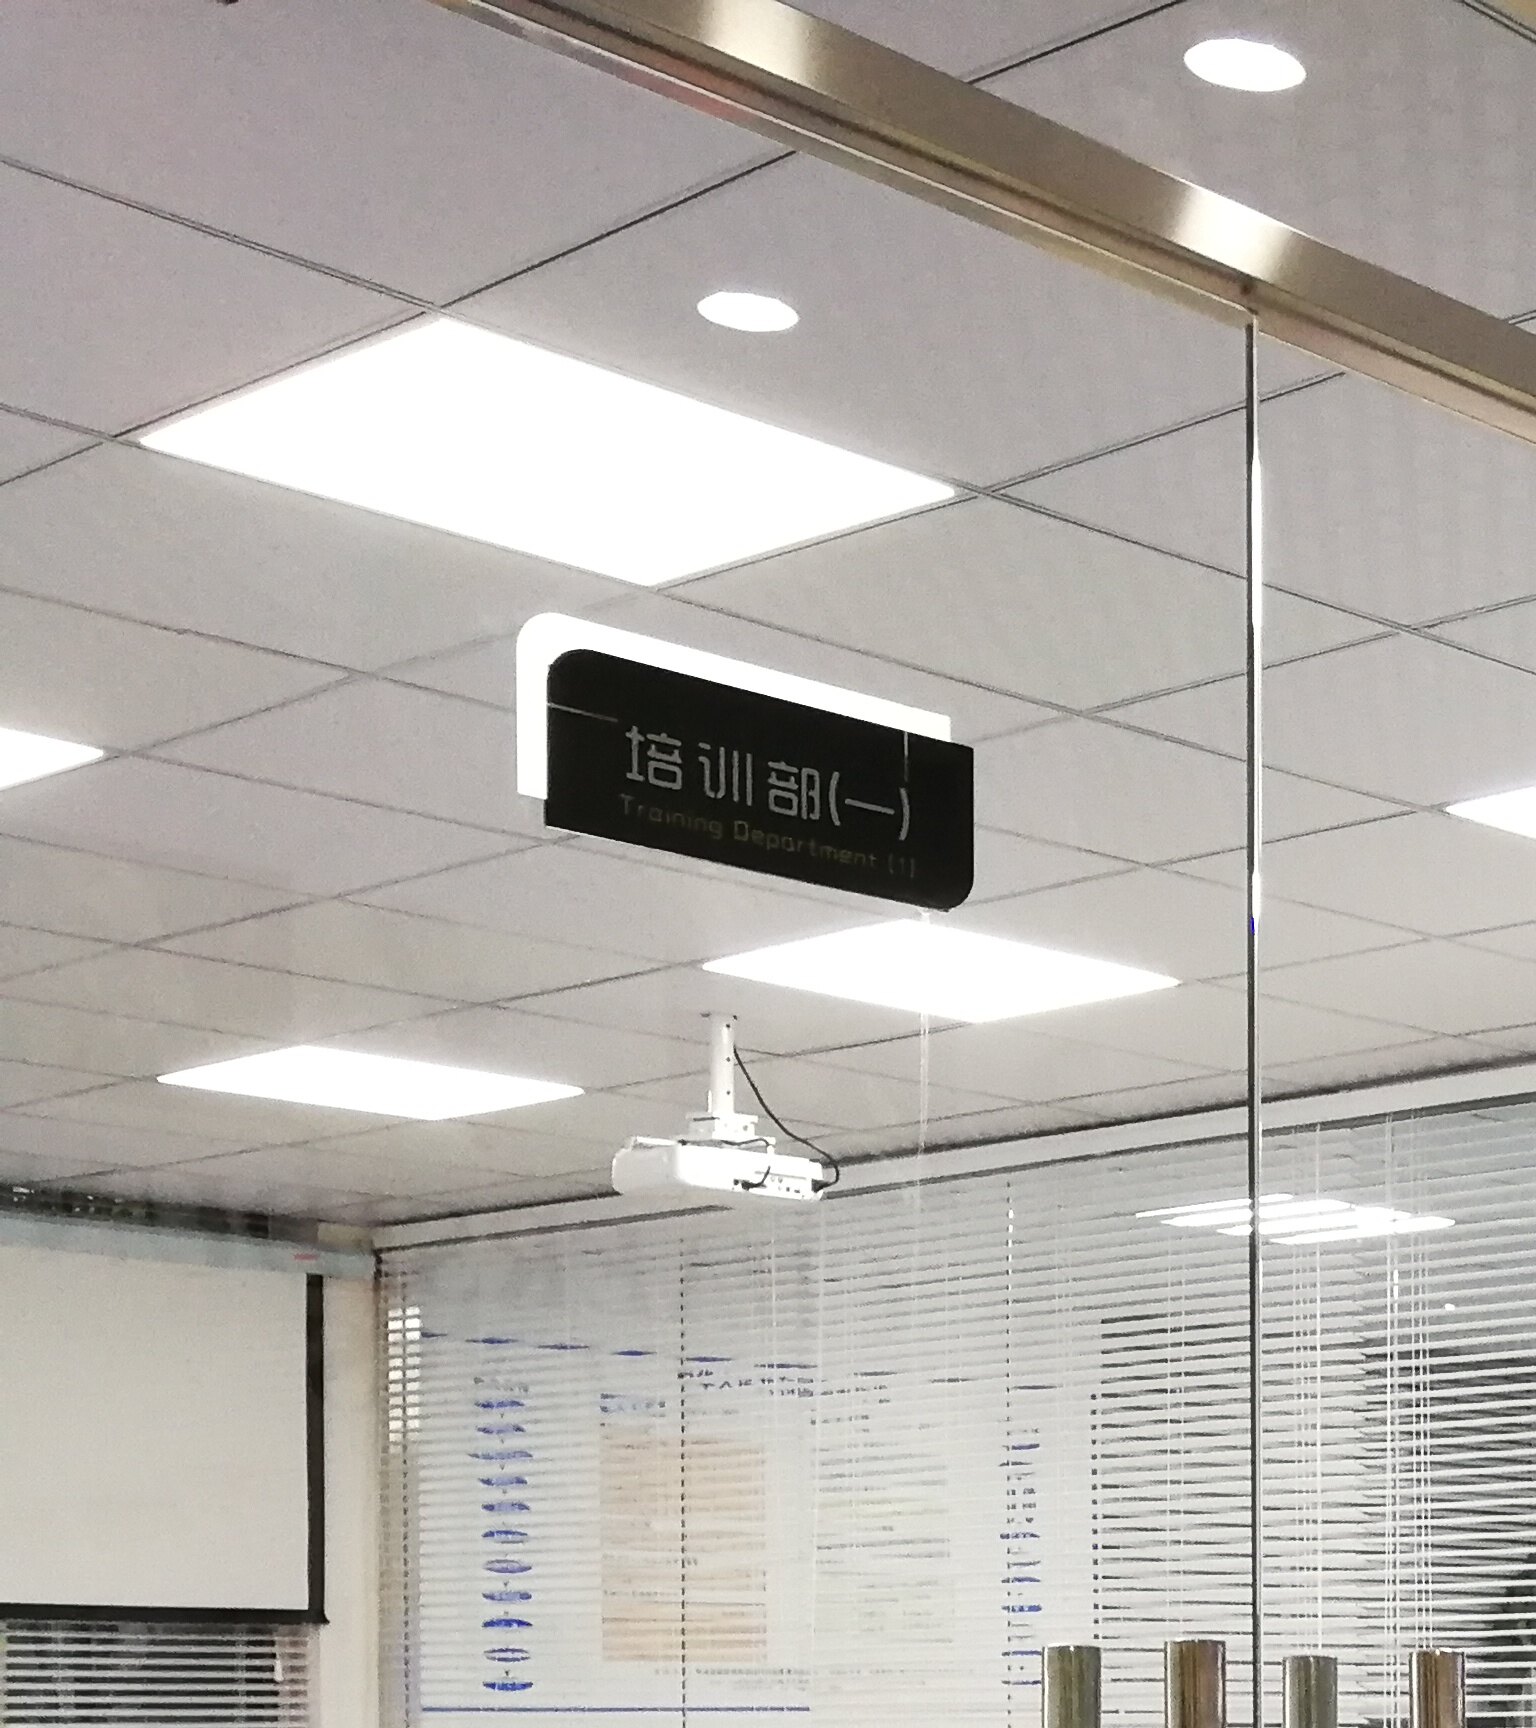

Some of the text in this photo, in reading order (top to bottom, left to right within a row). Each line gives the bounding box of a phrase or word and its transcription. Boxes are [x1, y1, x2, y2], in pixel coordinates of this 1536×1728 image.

[619, 791, 724, 841] Training
[732, 819, 878, 869] Department
[624, 725, 911, 841] 培训部(一)
